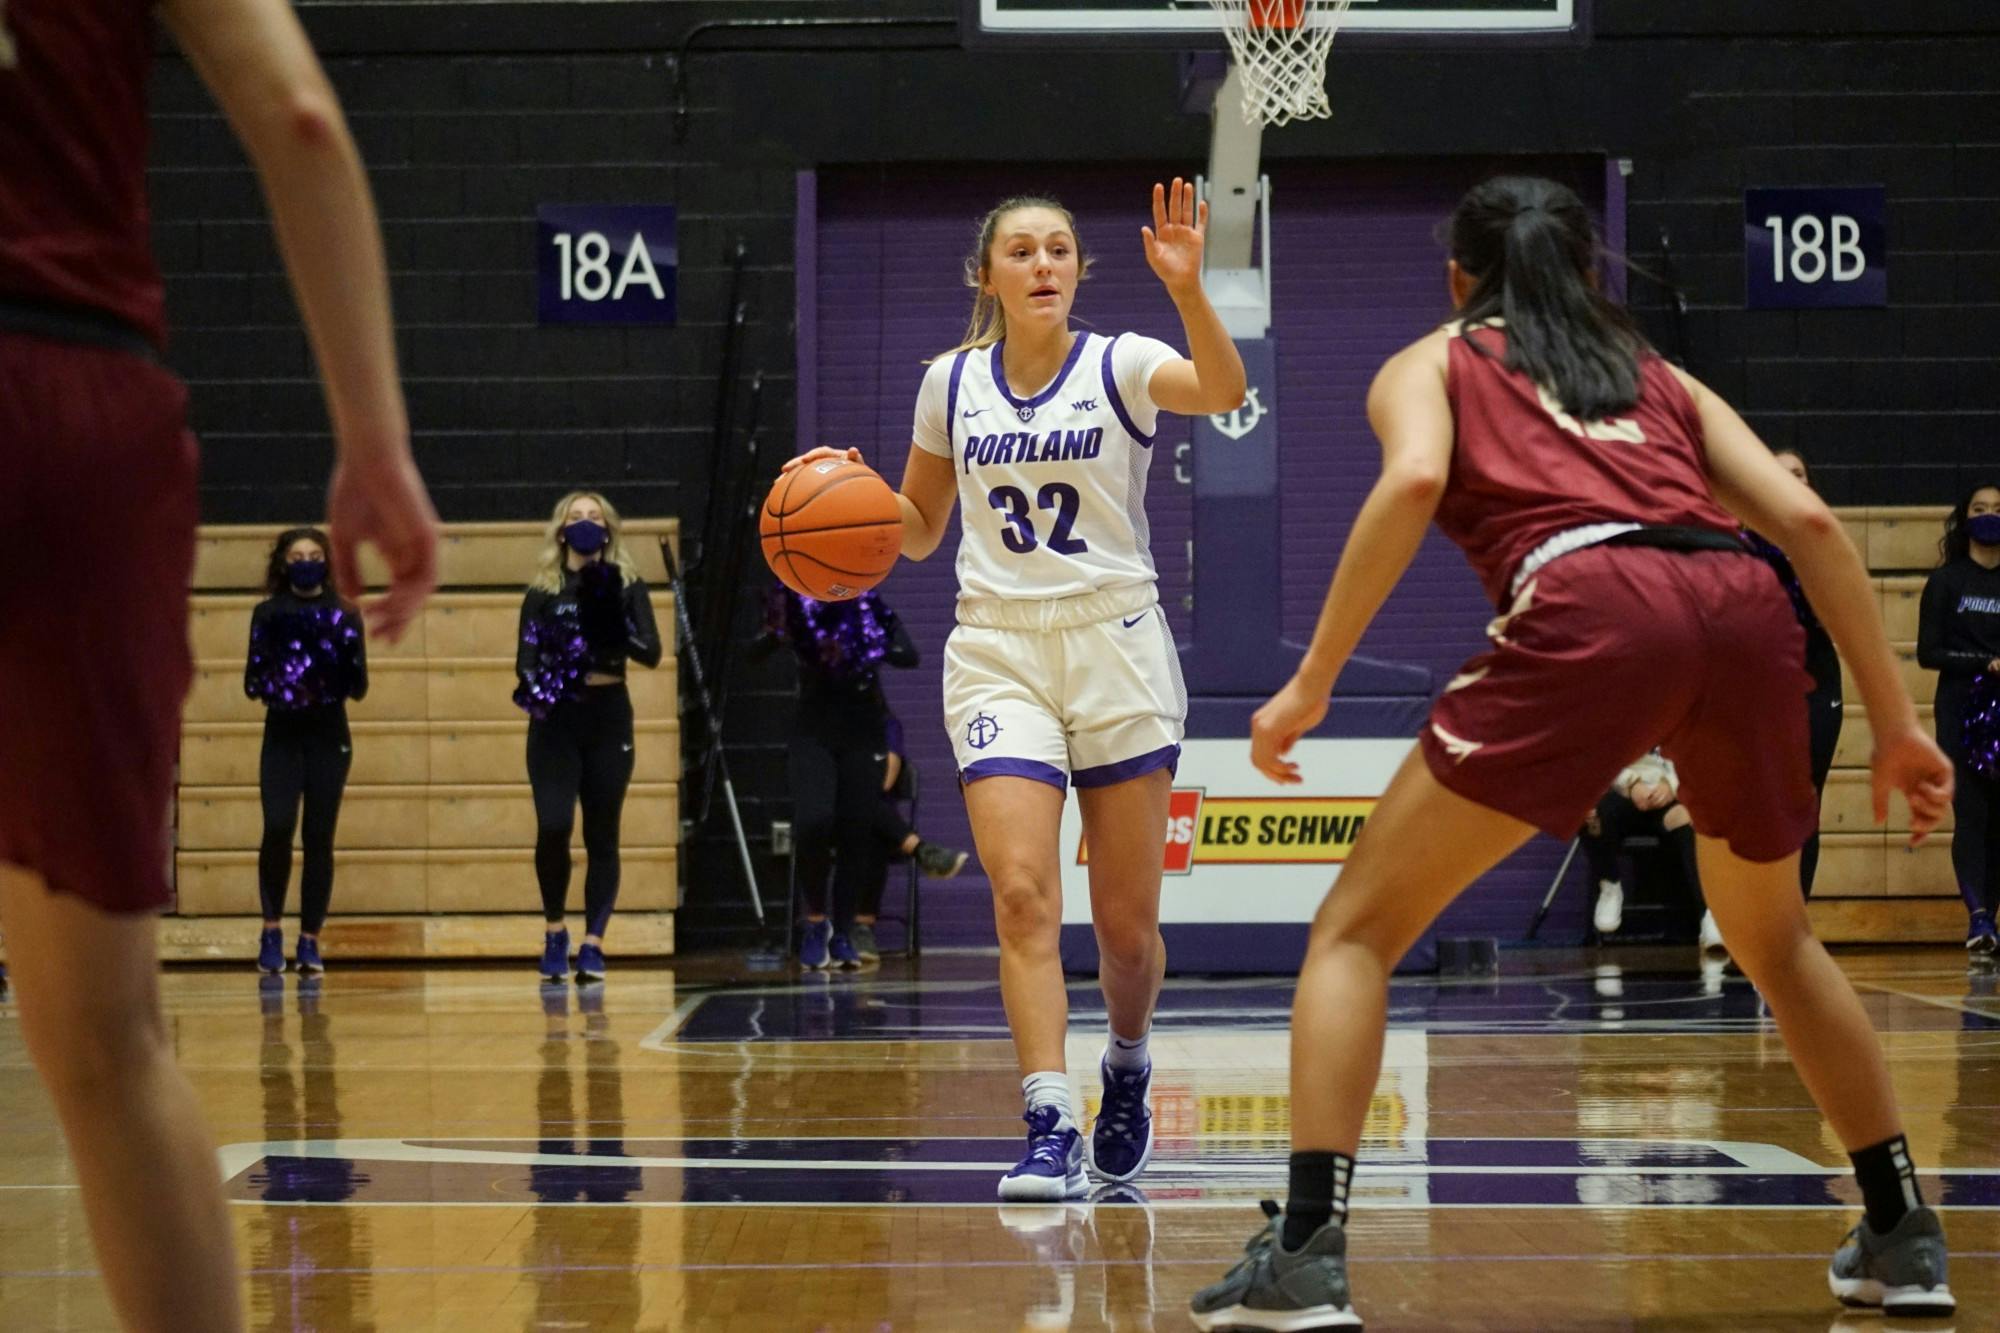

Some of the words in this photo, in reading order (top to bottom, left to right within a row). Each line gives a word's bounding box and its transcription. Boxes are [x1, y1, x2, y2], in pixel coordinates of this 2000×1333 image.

[553, 231, 665, 301] 18A
[1765, 214, 1866, 283] 18B
[963, 427, 1103, 474] PORTLAND
[988, 482, 1088, 555] 32
[1201, 815, 1251, 845] LES
[1257, 815, 1365, 845] SCHWA
